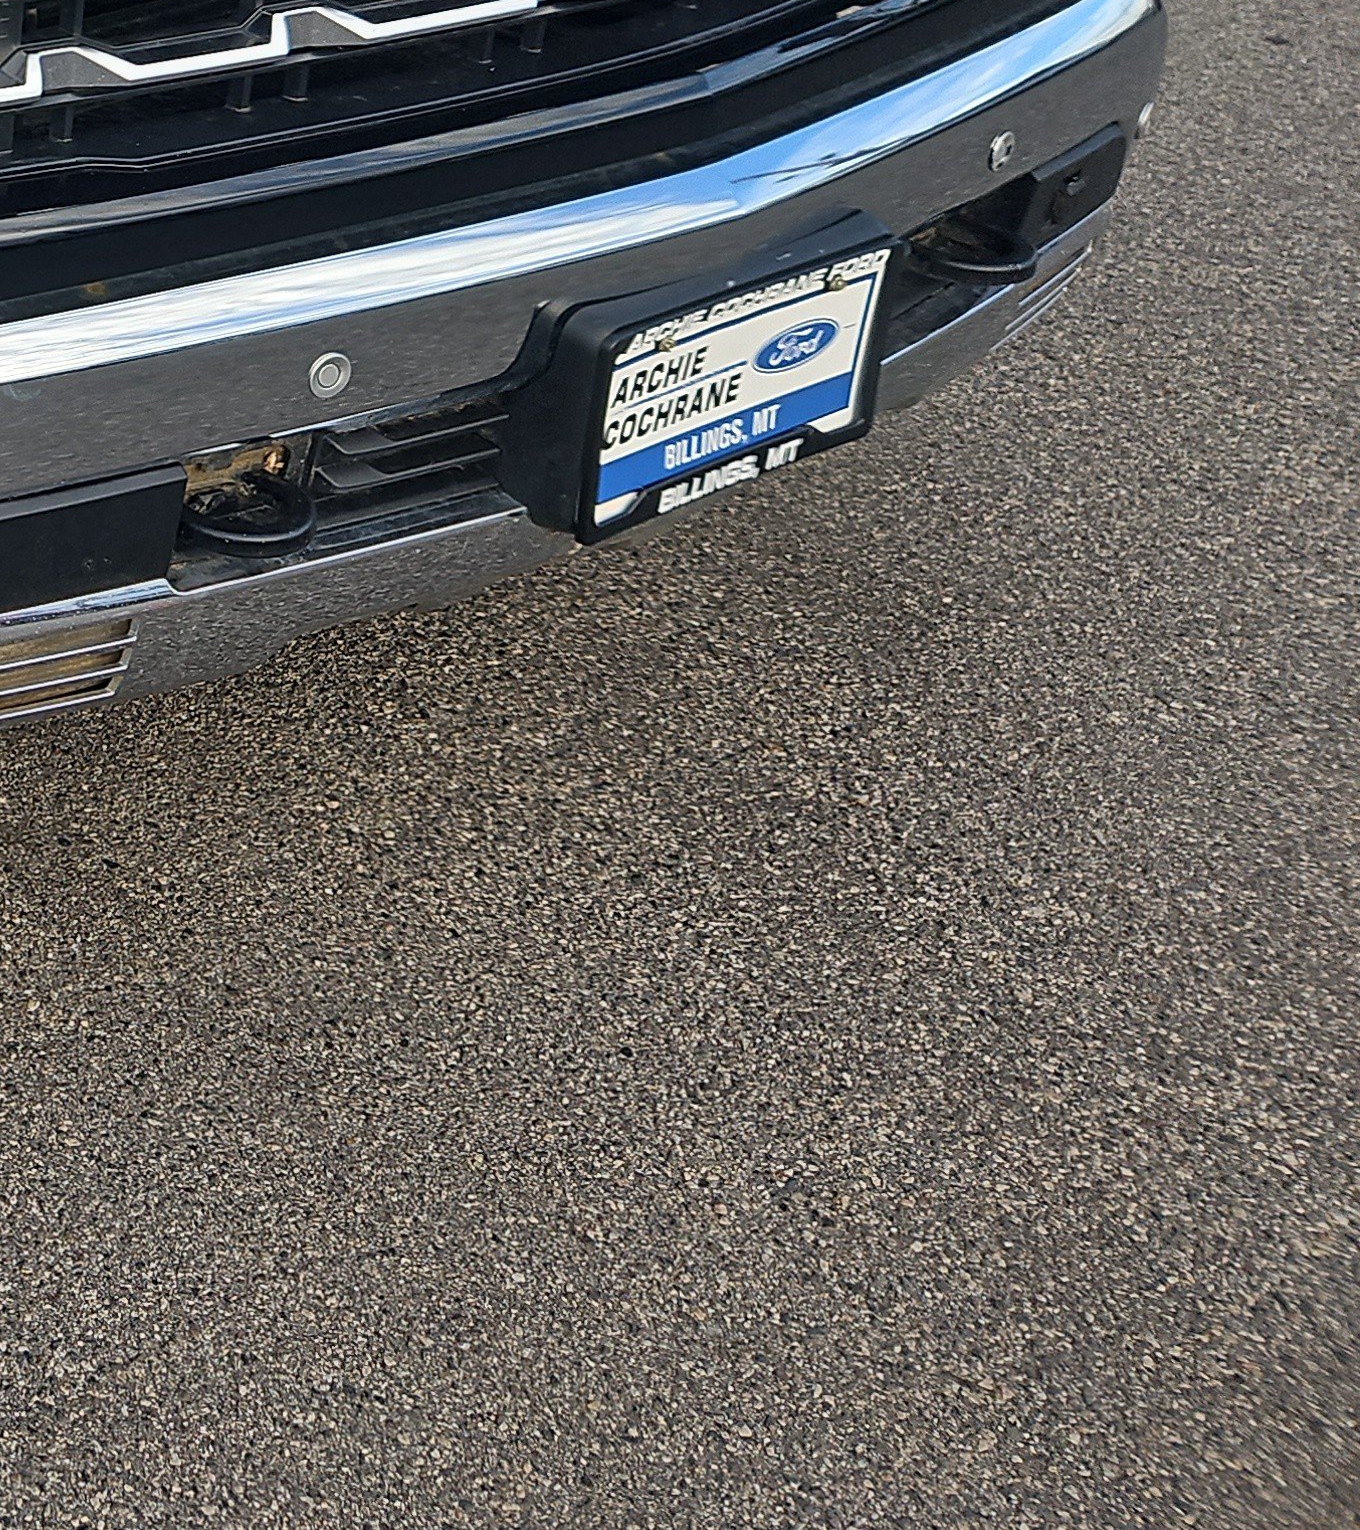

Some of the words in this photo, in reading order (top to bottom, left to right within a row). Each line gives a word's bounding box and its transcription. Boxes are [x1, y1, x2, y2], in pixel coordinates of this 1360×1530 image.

[630, 309, 708, 351] ARCHIE
[705, 268, 828, 319] COCHRANE
[826, 249, 891, 282] FORD
[610, 345, 709, 408] ARCHIE
[768, 327, 824, 367] Ford
[603, 374, 742, 450] COCHRANE
[664, 419, 749, 470] BILLINGS,
[751, 404, 781, 436] MT
[657, 455, 761, 514] BILLINGS,
[765, 438, 805, 470] MT
